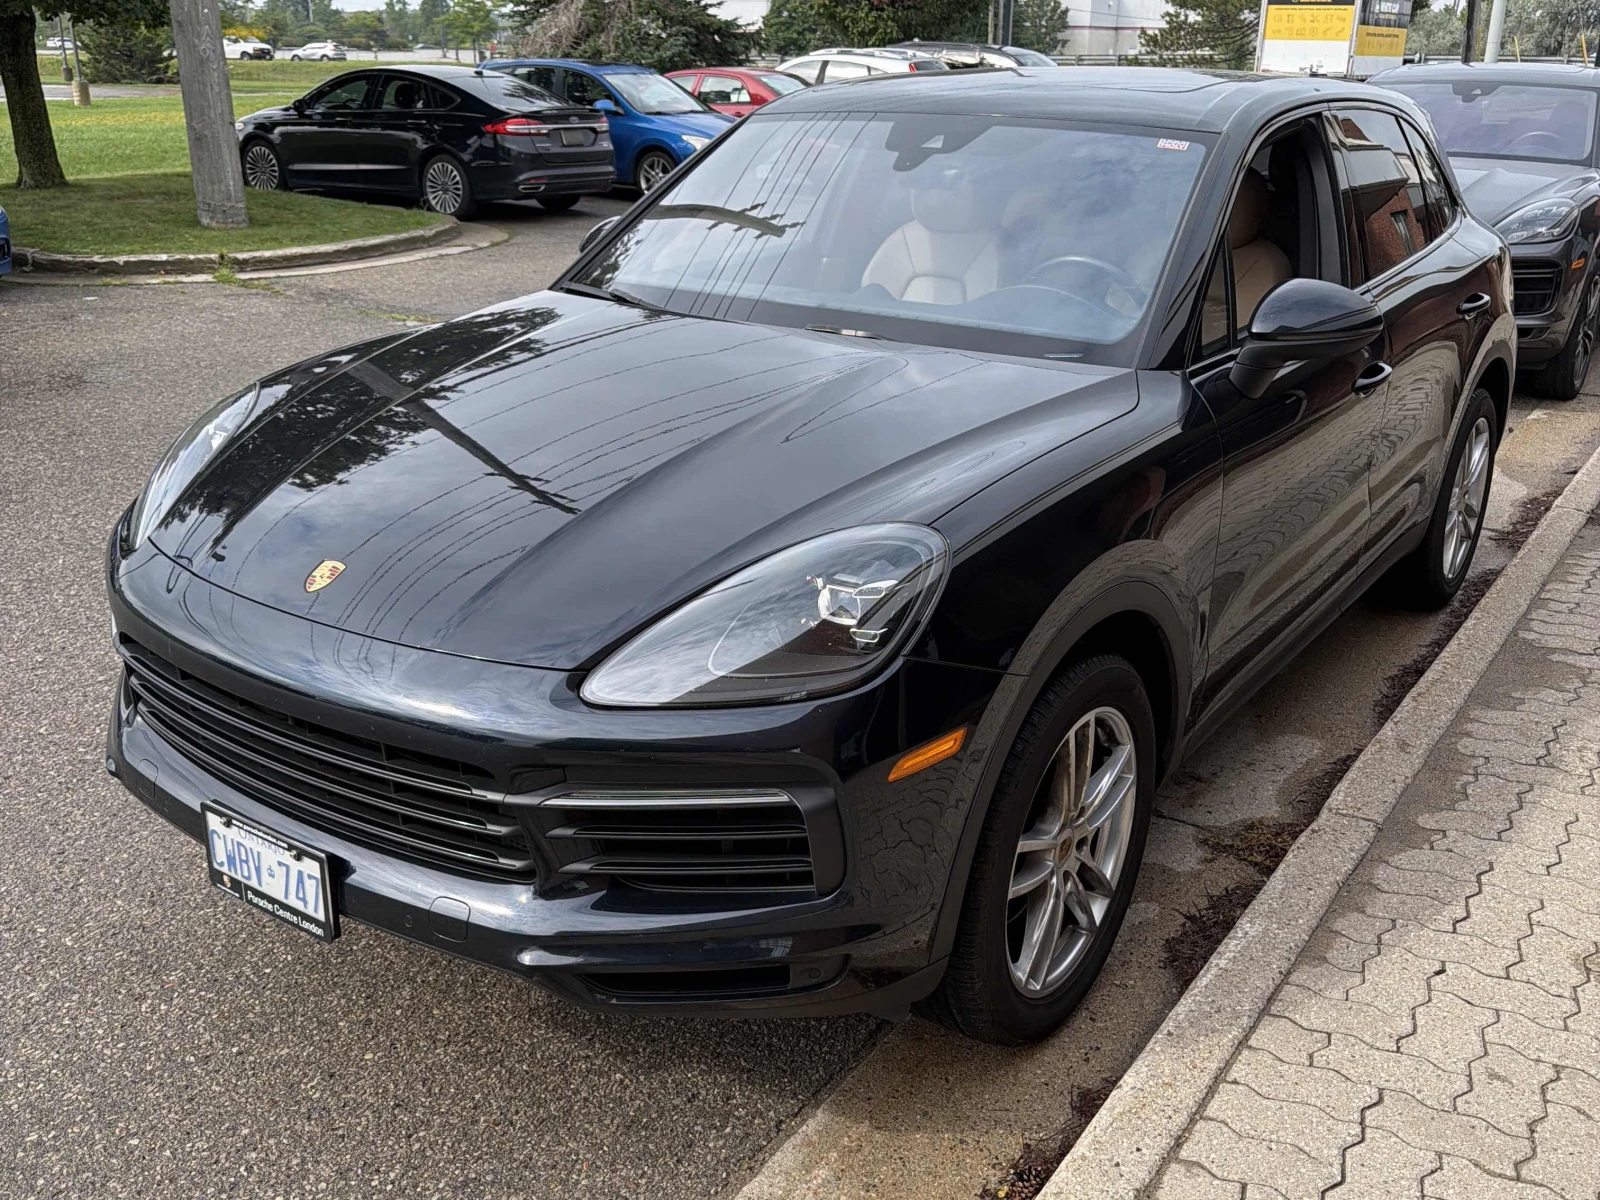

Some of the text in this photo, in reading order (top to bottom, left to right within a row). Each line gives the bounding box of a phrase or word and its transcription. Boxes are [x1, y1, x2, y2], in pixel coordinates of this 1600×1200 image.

[209, 828, 320, 915] CWBV 747
[247, 890, 274, 912] Porsche
[274, 904, 298, 924] Centre
[298, 917, 325, 938] London
